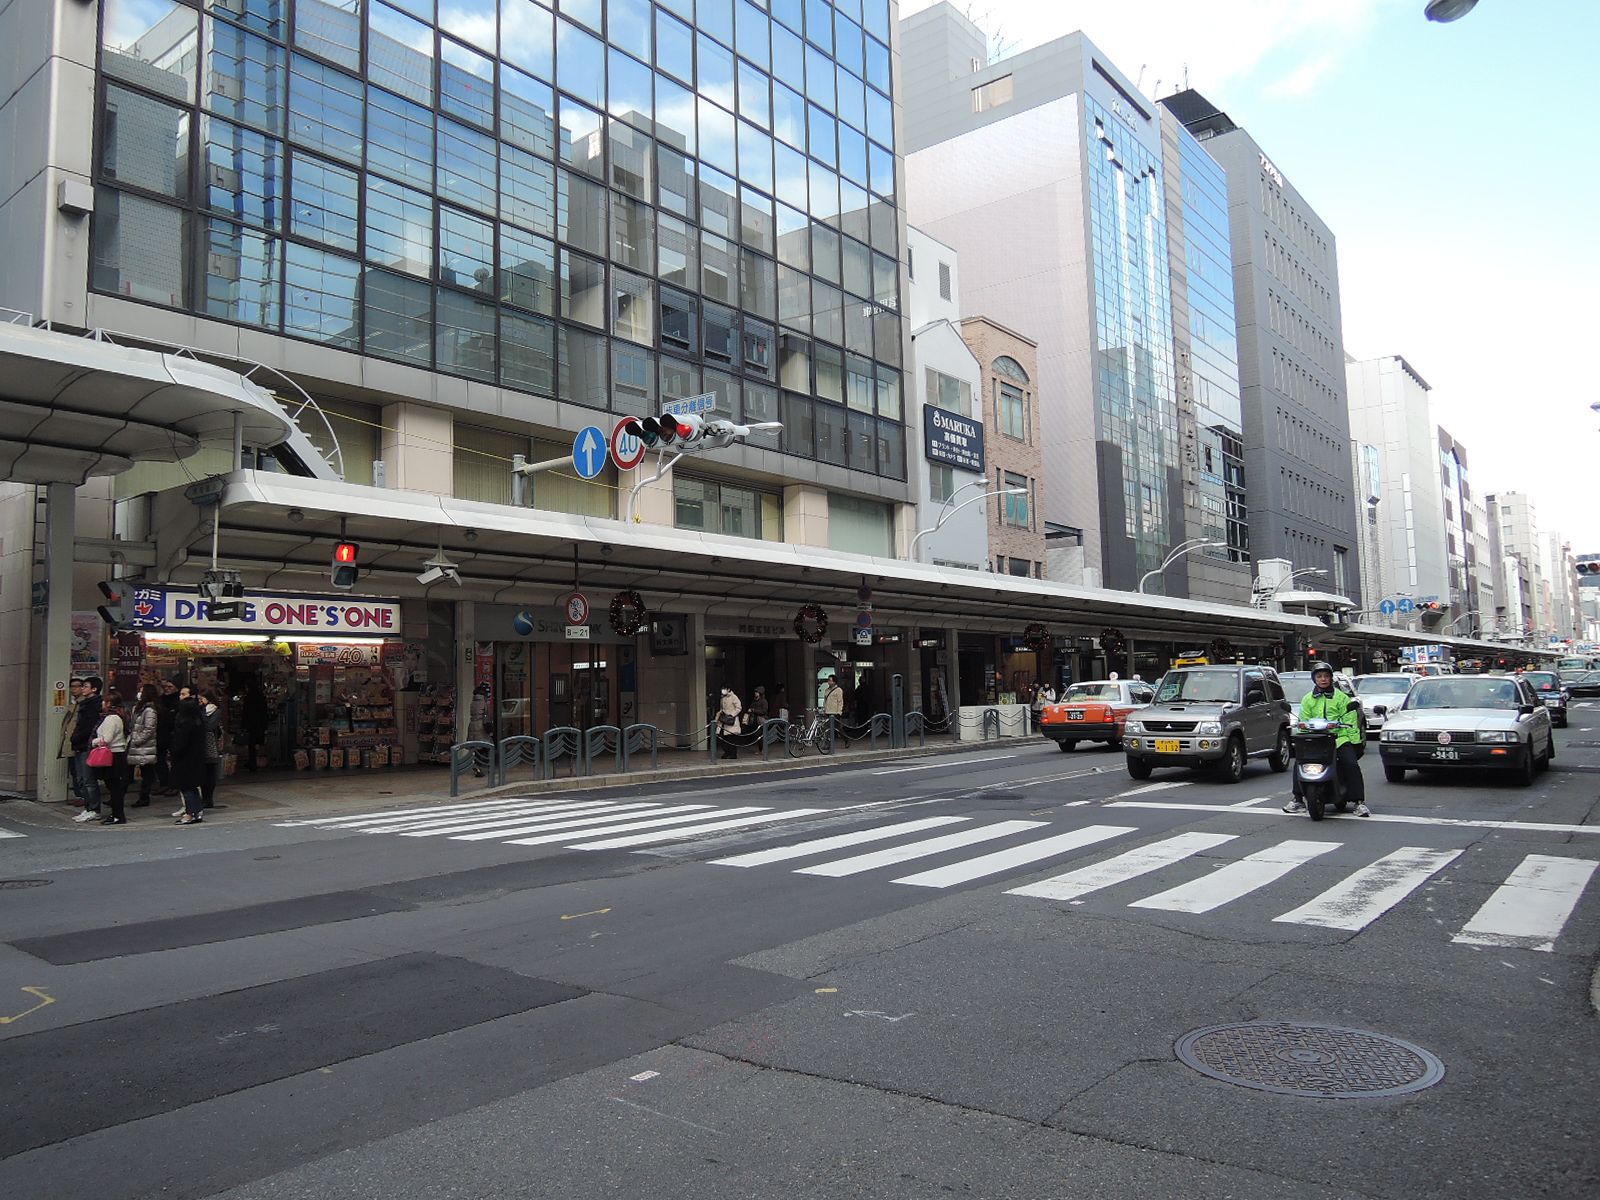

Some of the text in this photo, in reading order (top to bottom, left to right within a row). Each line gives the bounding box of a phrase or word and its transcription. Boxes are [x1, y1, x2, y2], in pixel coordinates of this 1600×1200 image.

[941, 417, 976, 438] MARUKA
[619, 432, 638, 455] 40
[175, 599, 256, 622] DRG
